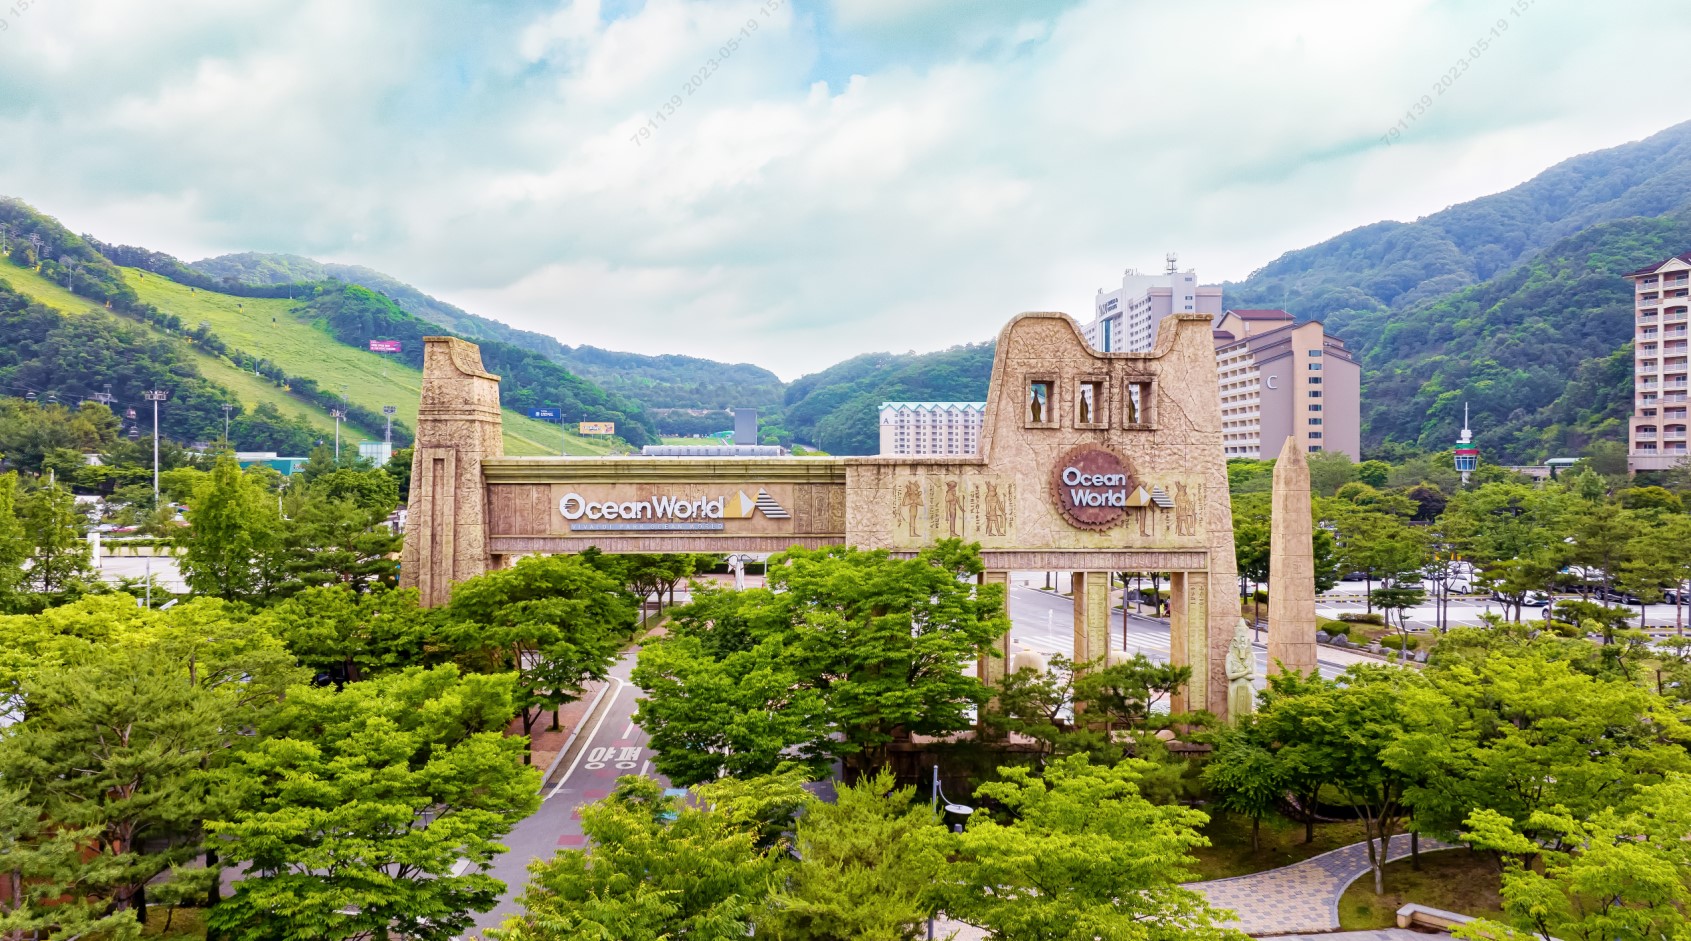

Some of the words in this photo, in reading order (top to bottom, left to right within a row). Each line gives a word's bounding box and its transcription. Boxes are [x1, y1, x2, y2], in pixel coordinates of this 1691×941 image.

[1267, 375, 1278, 389] C
[1062, 466, 1126, 486] Ocean
[559, 492, 724, 520] OceanWorld
[1070, 488, 1126, 507] World
[584, 746, 643, 770] 양평
